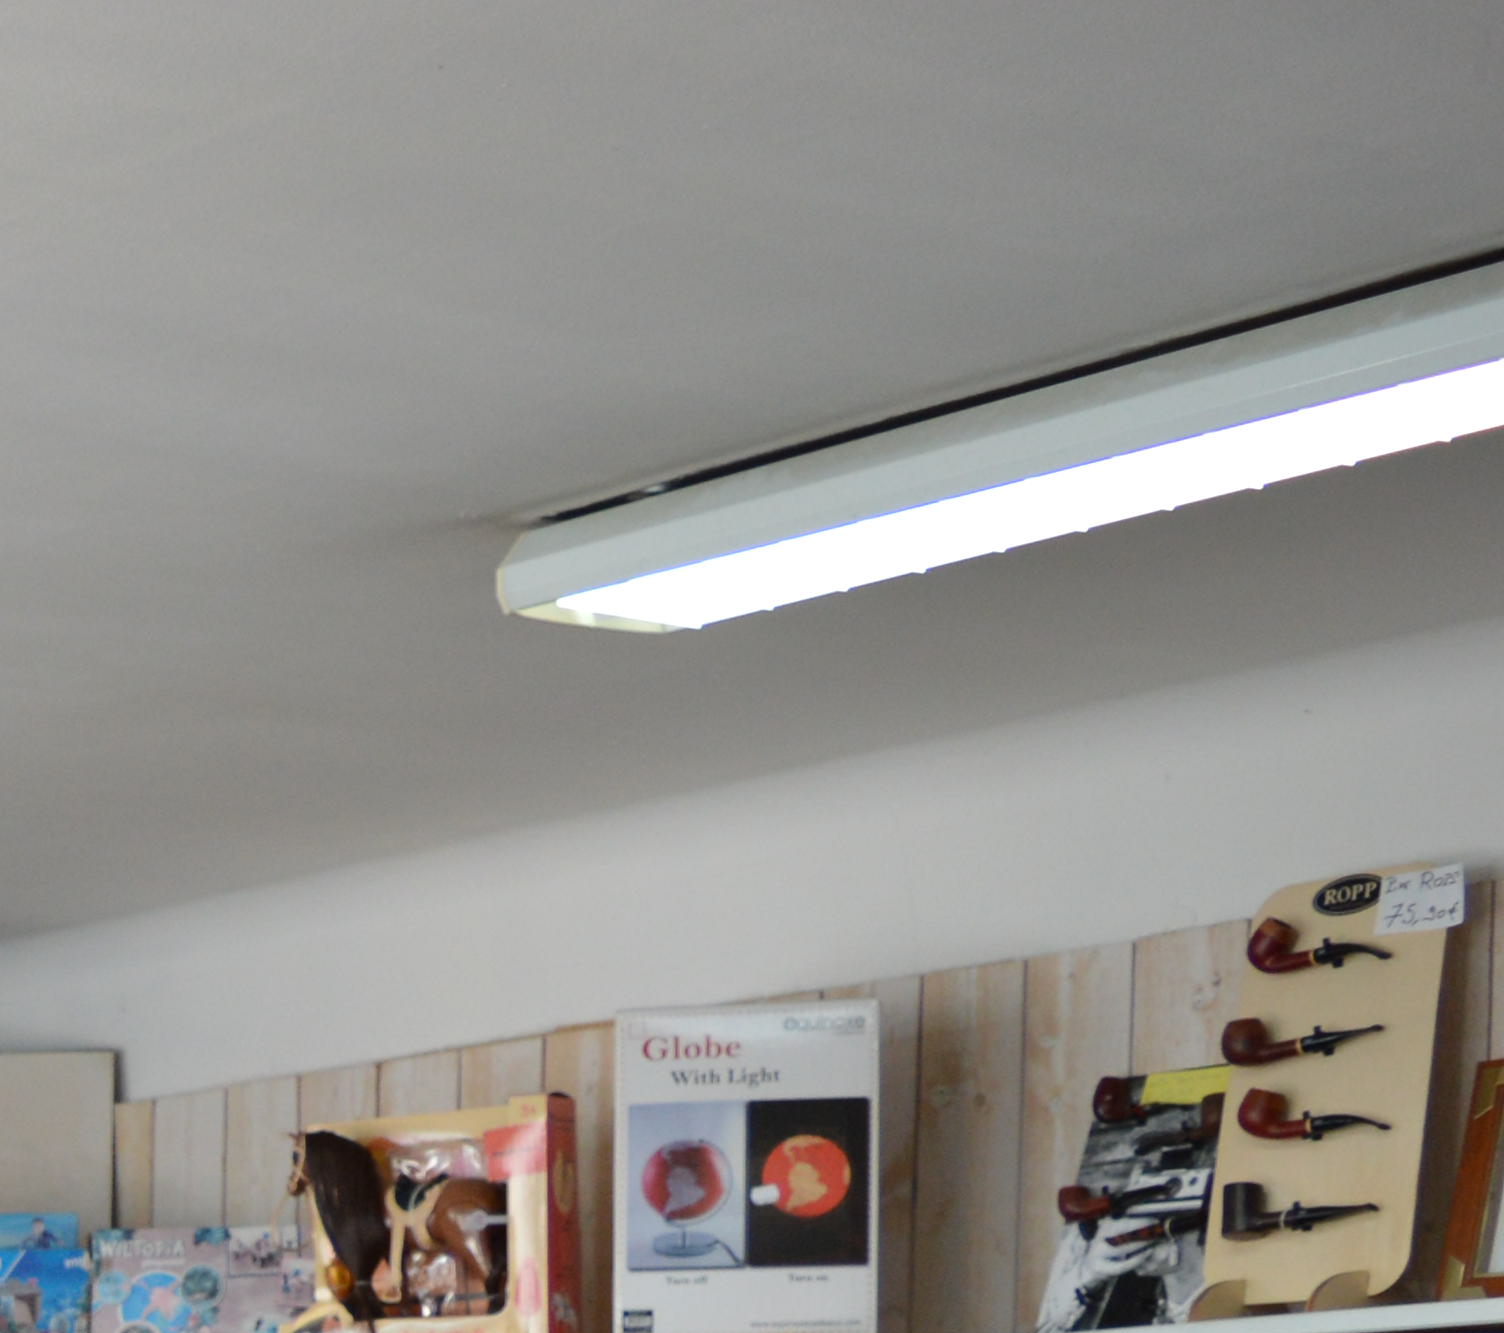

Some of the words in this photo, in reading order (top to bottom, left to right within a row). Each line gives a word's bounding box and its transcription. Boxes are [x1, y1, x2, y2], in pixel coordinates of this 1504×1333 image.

[1323, 880, 1378, 906] ROPP
[642, 1034, 741, 1062] Globe
[670, 1068, 720, 1086] With
[728, 1067, 780, 1089] Light
